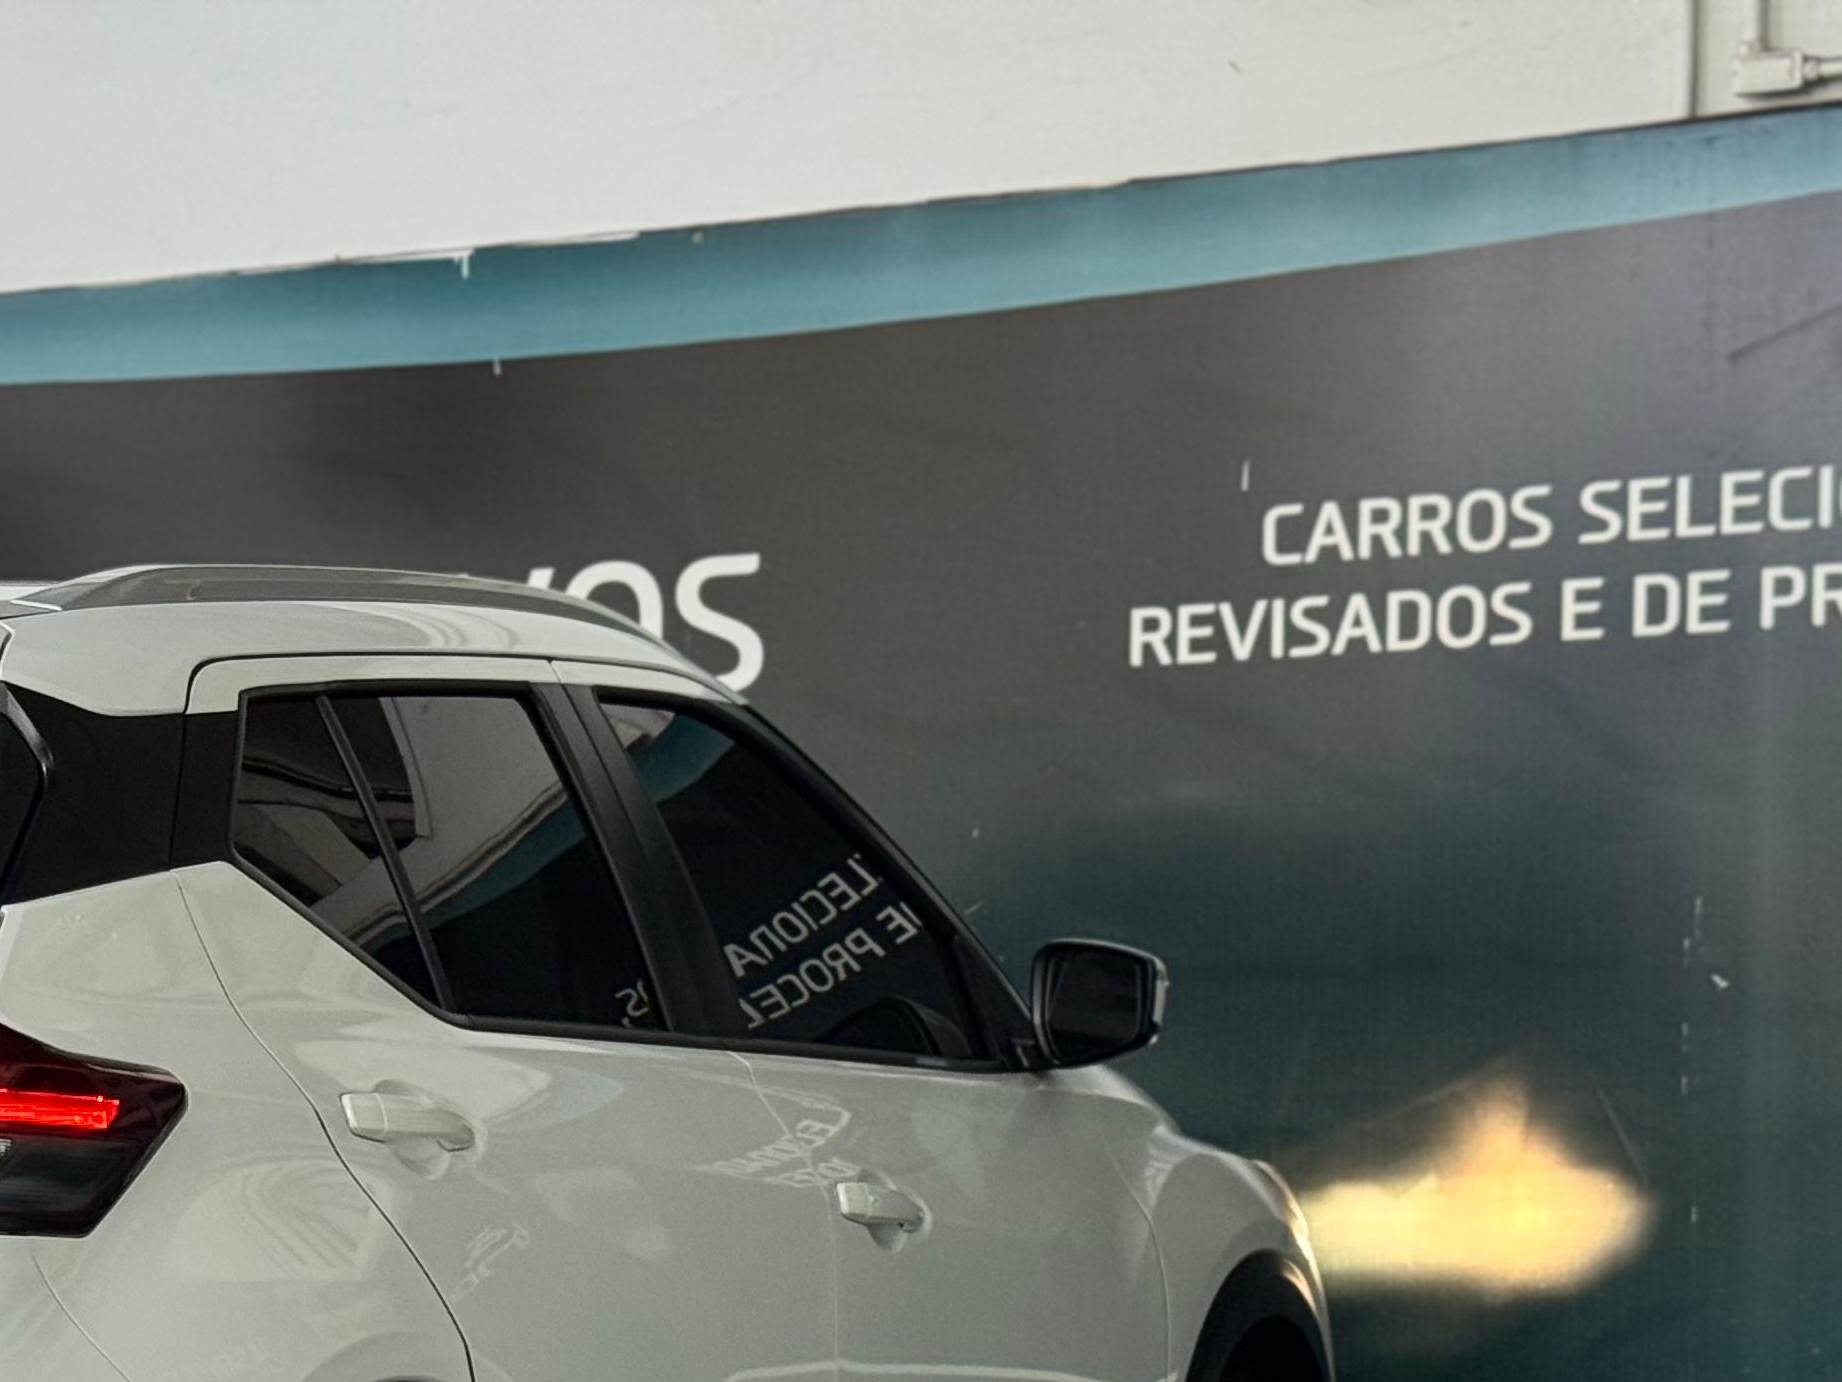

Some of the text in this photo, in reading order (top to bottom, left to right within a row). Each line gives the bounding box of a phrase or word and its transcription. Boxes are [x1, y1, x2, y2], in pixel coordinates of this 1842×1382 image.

[1261, 464, 1842, 566] CARROS SELECI
[1128, 582, 1533, 667] REVISADOS
[1560, 576, 1605, 641] E
[1631, 568, 1732, 637] DE
